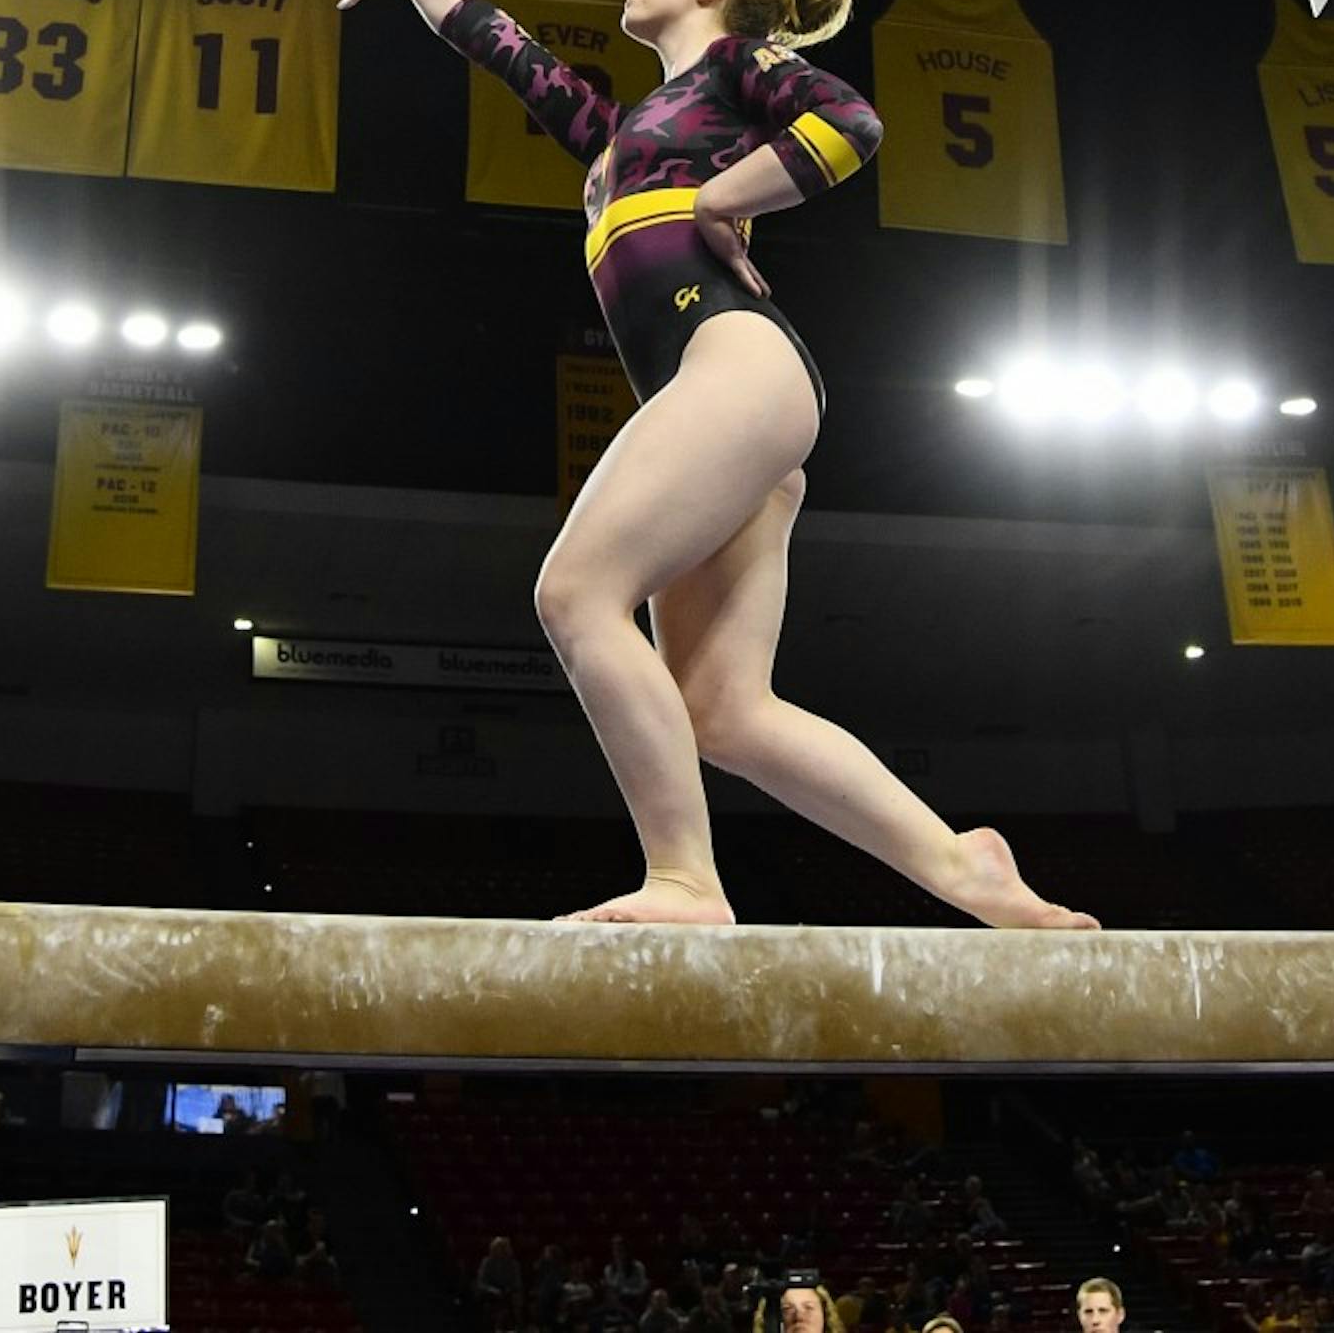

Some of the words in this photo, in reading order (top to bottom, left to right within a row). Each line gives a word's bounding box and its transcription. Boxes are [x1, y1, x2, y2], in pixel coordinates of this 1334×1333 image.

[193, 31, 281, 114] 11
[916, 44, 1012, 82] HOUSE
[942, 92, 995, 168] 5
[276, 643, 394, 669] bluemedia
[19, 1279, 126, 1315] BOYER
